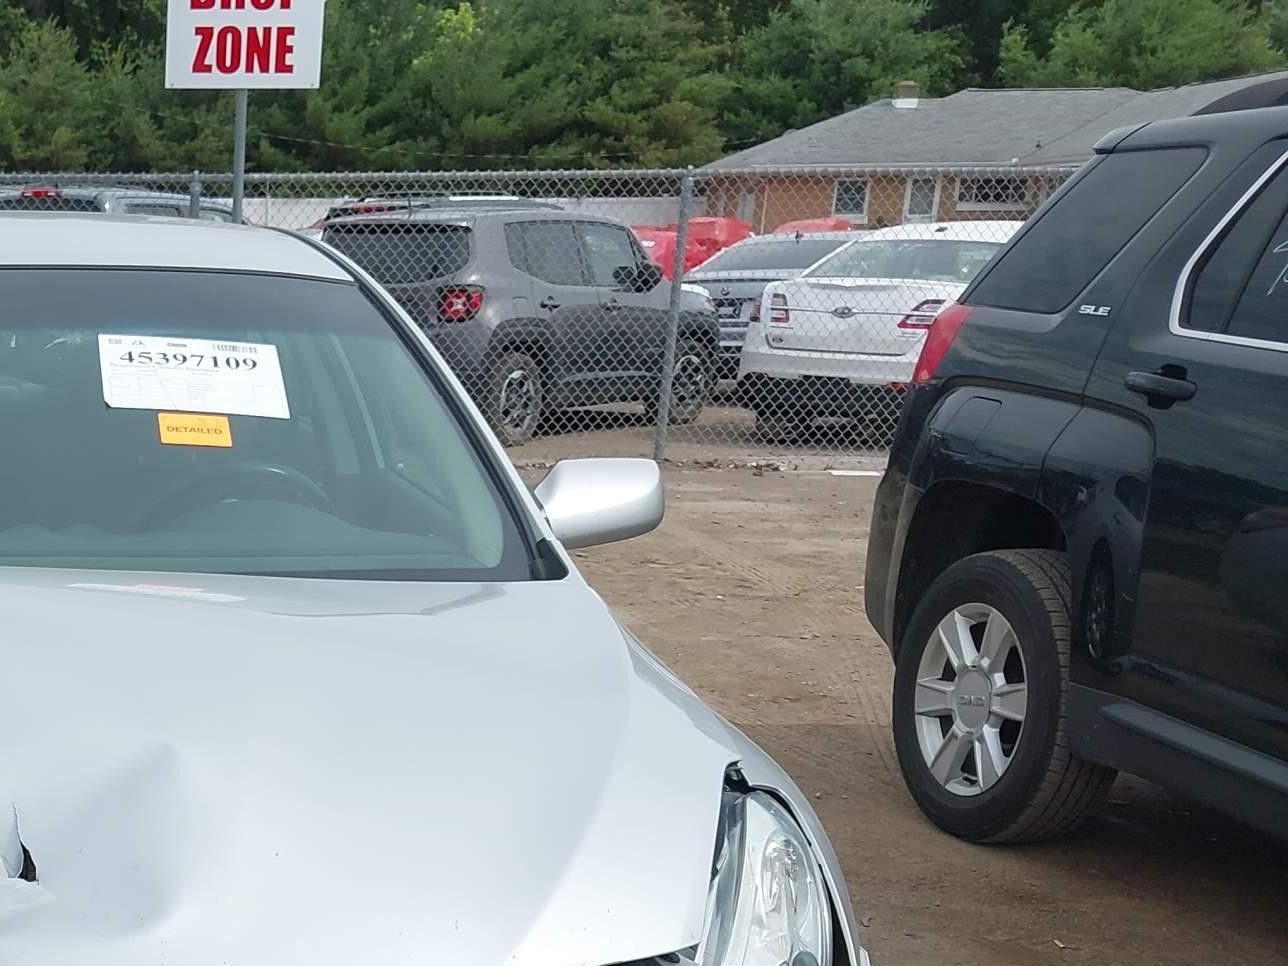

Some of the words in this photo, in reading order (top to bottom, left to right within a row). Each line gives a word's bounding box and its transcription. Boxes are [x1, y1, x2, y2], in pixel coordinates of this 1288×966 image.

[192, 26, 295, 74] ZONE
[1078, 304, 1111, 316] SLE
[119, 350, 258, 371] 45397109
[166, 425, 223, 435] DETAILED
